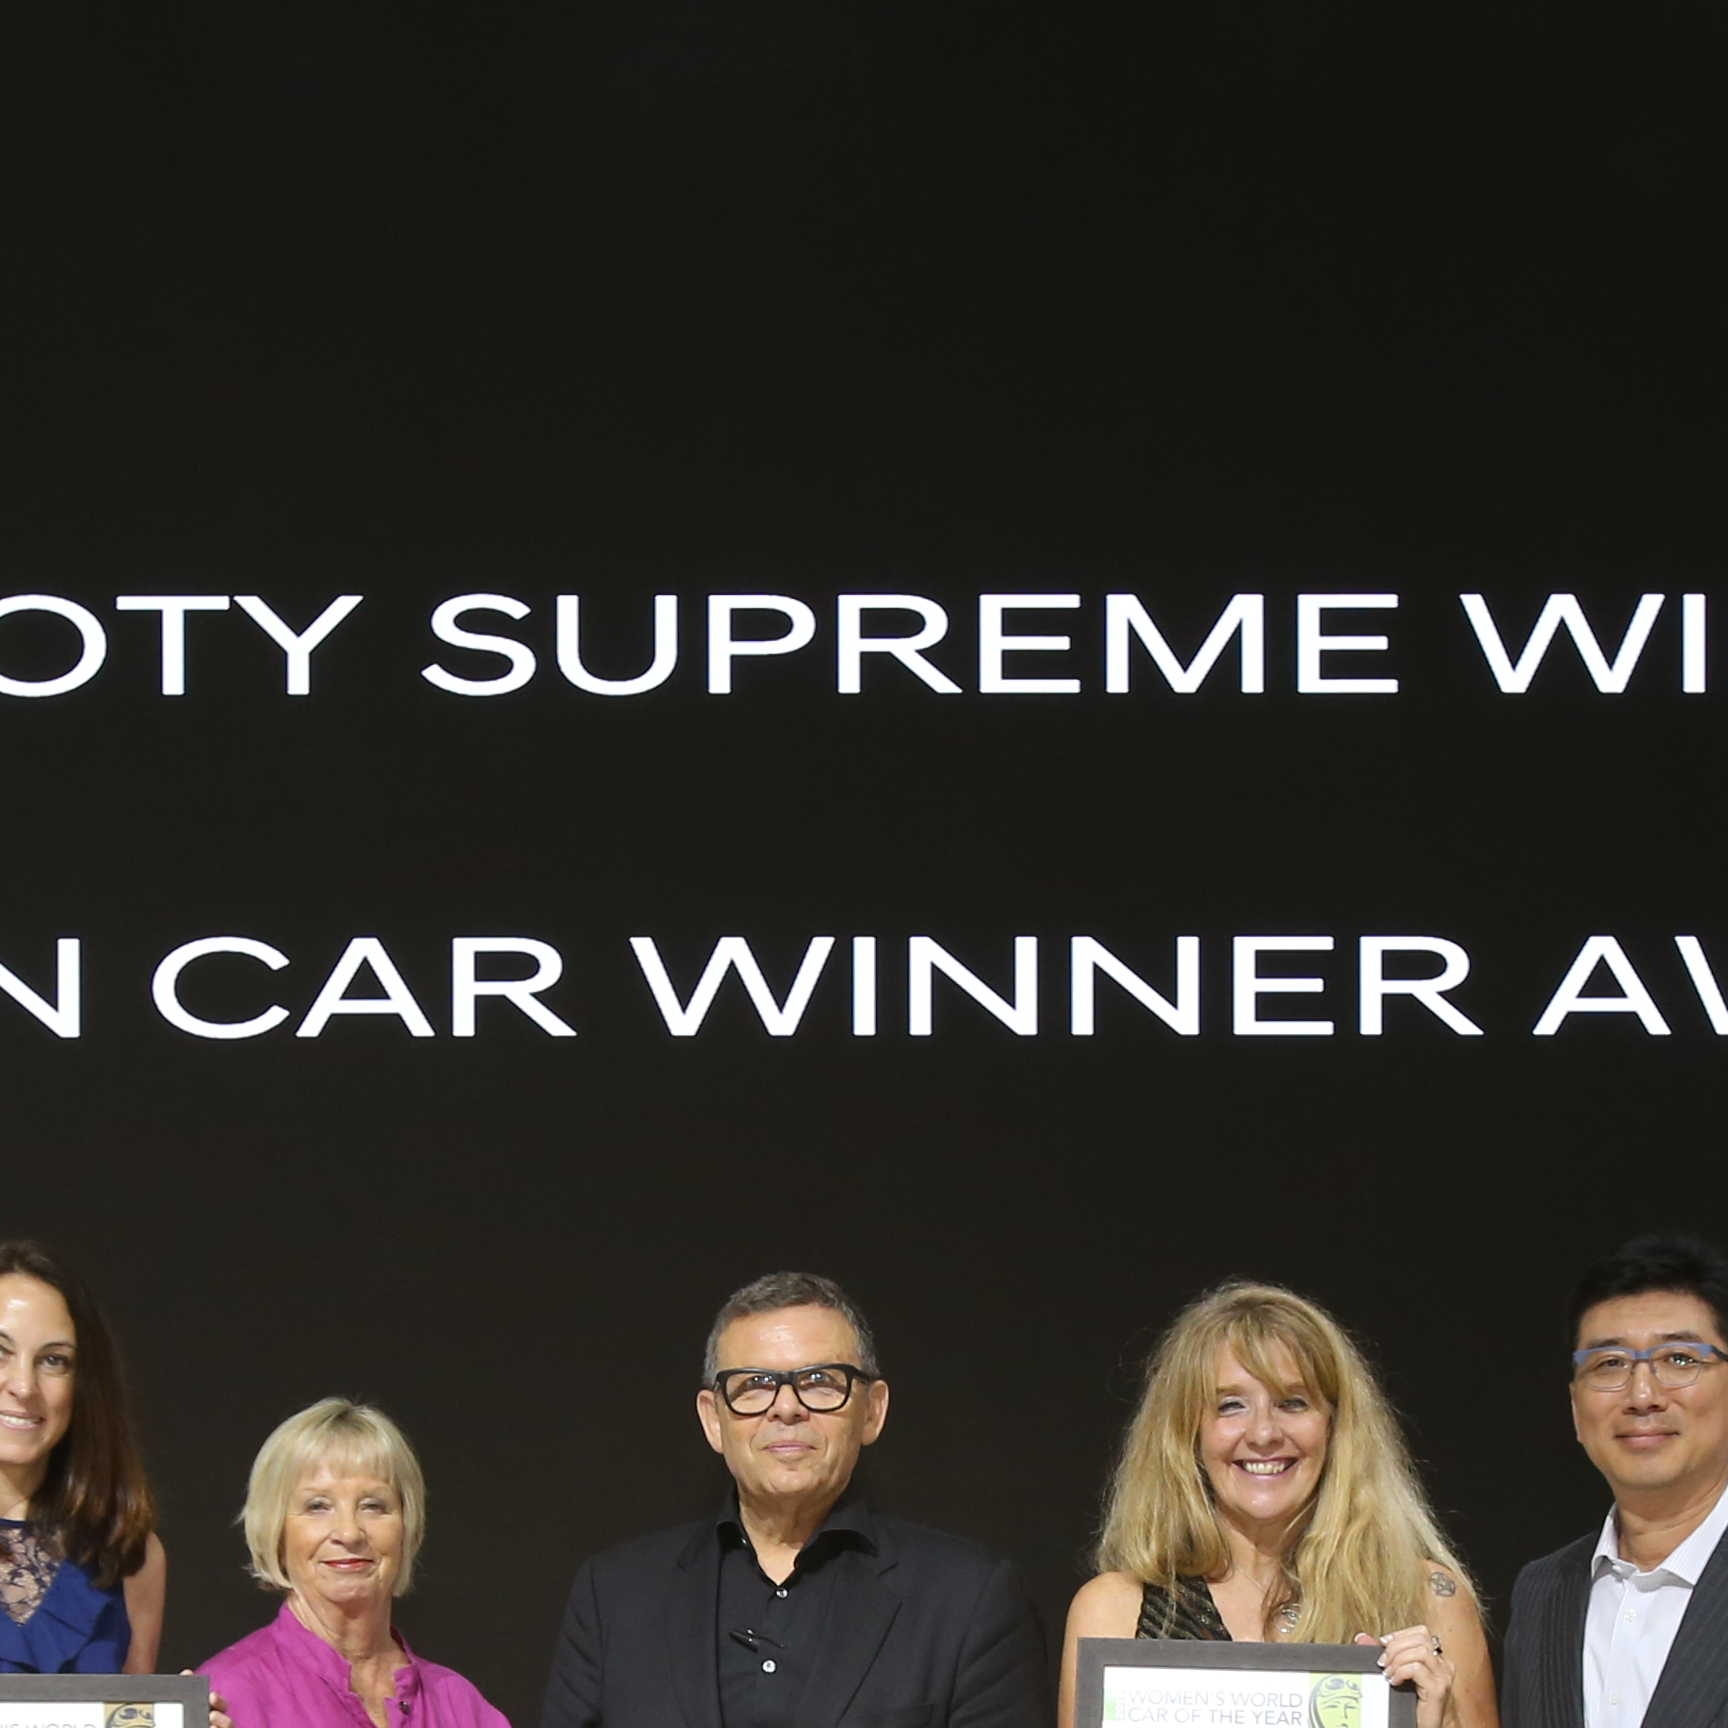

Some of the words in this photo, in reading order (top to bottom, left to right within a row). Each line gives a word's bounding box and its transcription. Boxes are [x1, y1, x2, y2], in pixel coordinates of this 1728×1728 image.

[422, 594, 1398, 696] SUPREME
[153, 937, 576, 1039] CAR
[630, 936, 1483, 1036] WINNER
[1128, 1688, 1225, 1706] WOMEN'S
[1229, 1691, 1303, 1708] WORLD
[1128, 1706, 1169, 1723] CAR
[1174, 1707, 1201, 1724] OF
[1208, 1708, 1246, 1725] THE
[1252, 1710, 1303, 1726] YEAR
